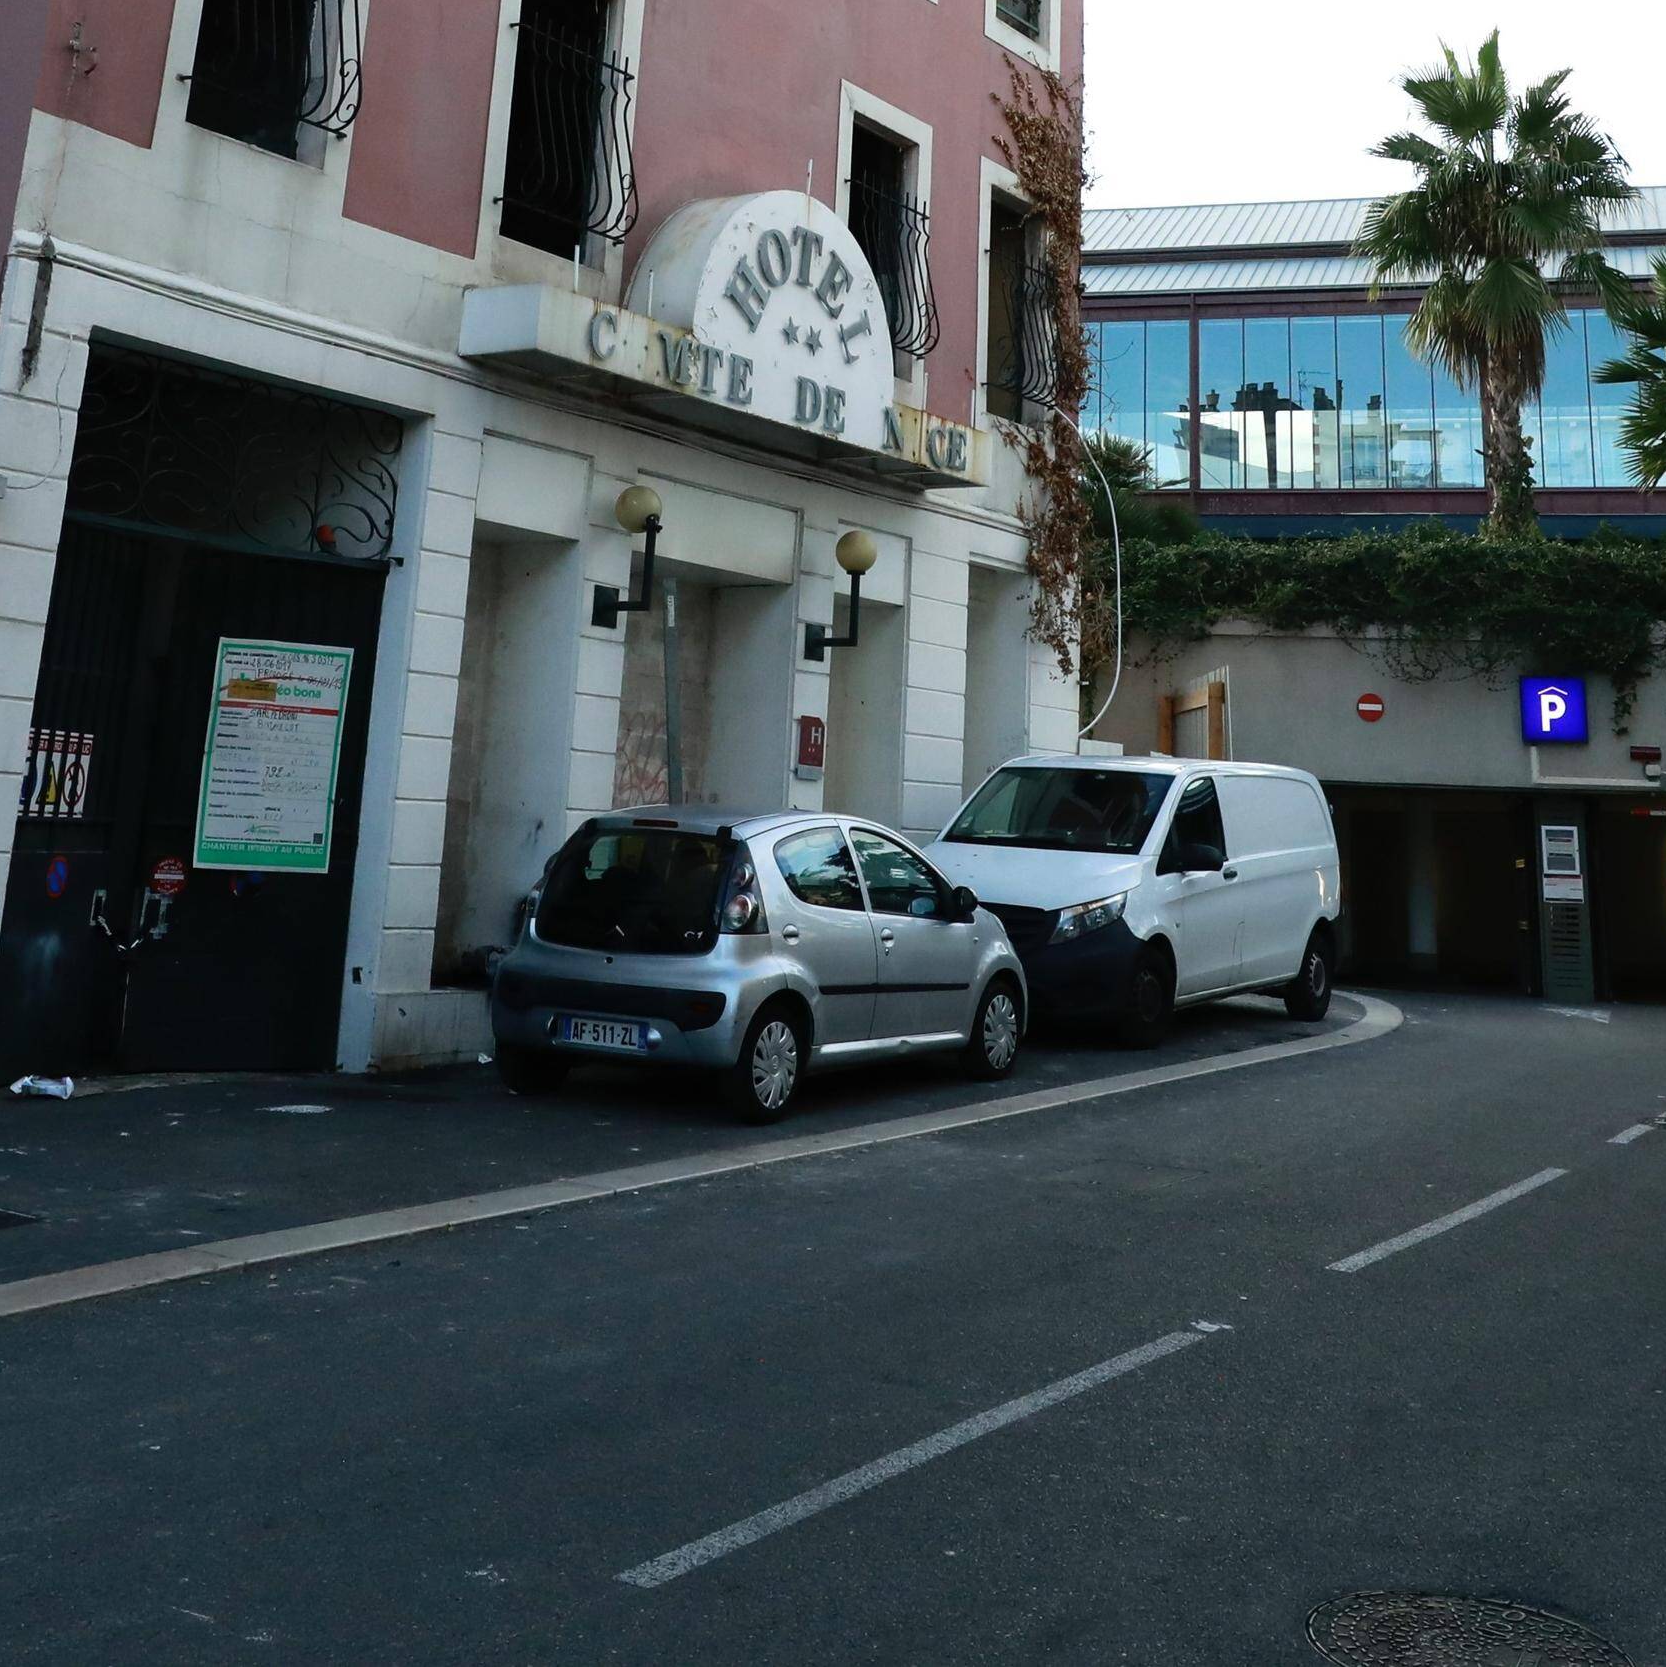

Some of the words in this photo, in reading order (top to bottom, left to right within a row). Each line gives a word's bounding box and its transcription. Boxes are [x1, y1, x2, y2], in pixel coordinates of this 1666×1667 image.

[725, 225, 873, 365] HOTEL
[590, 310, 754, 405] CMTE
[794, 375, 846, 434] DE
[882, 406, 967, 471] NCE
[1540, 694, 1566, 732] P
[811, 726, 821, 745] H
[201, 842, 245, 851] CHANTIER
[281, 845, 293, 854] AU
[294, 846, 324, 855] PUBLIC
